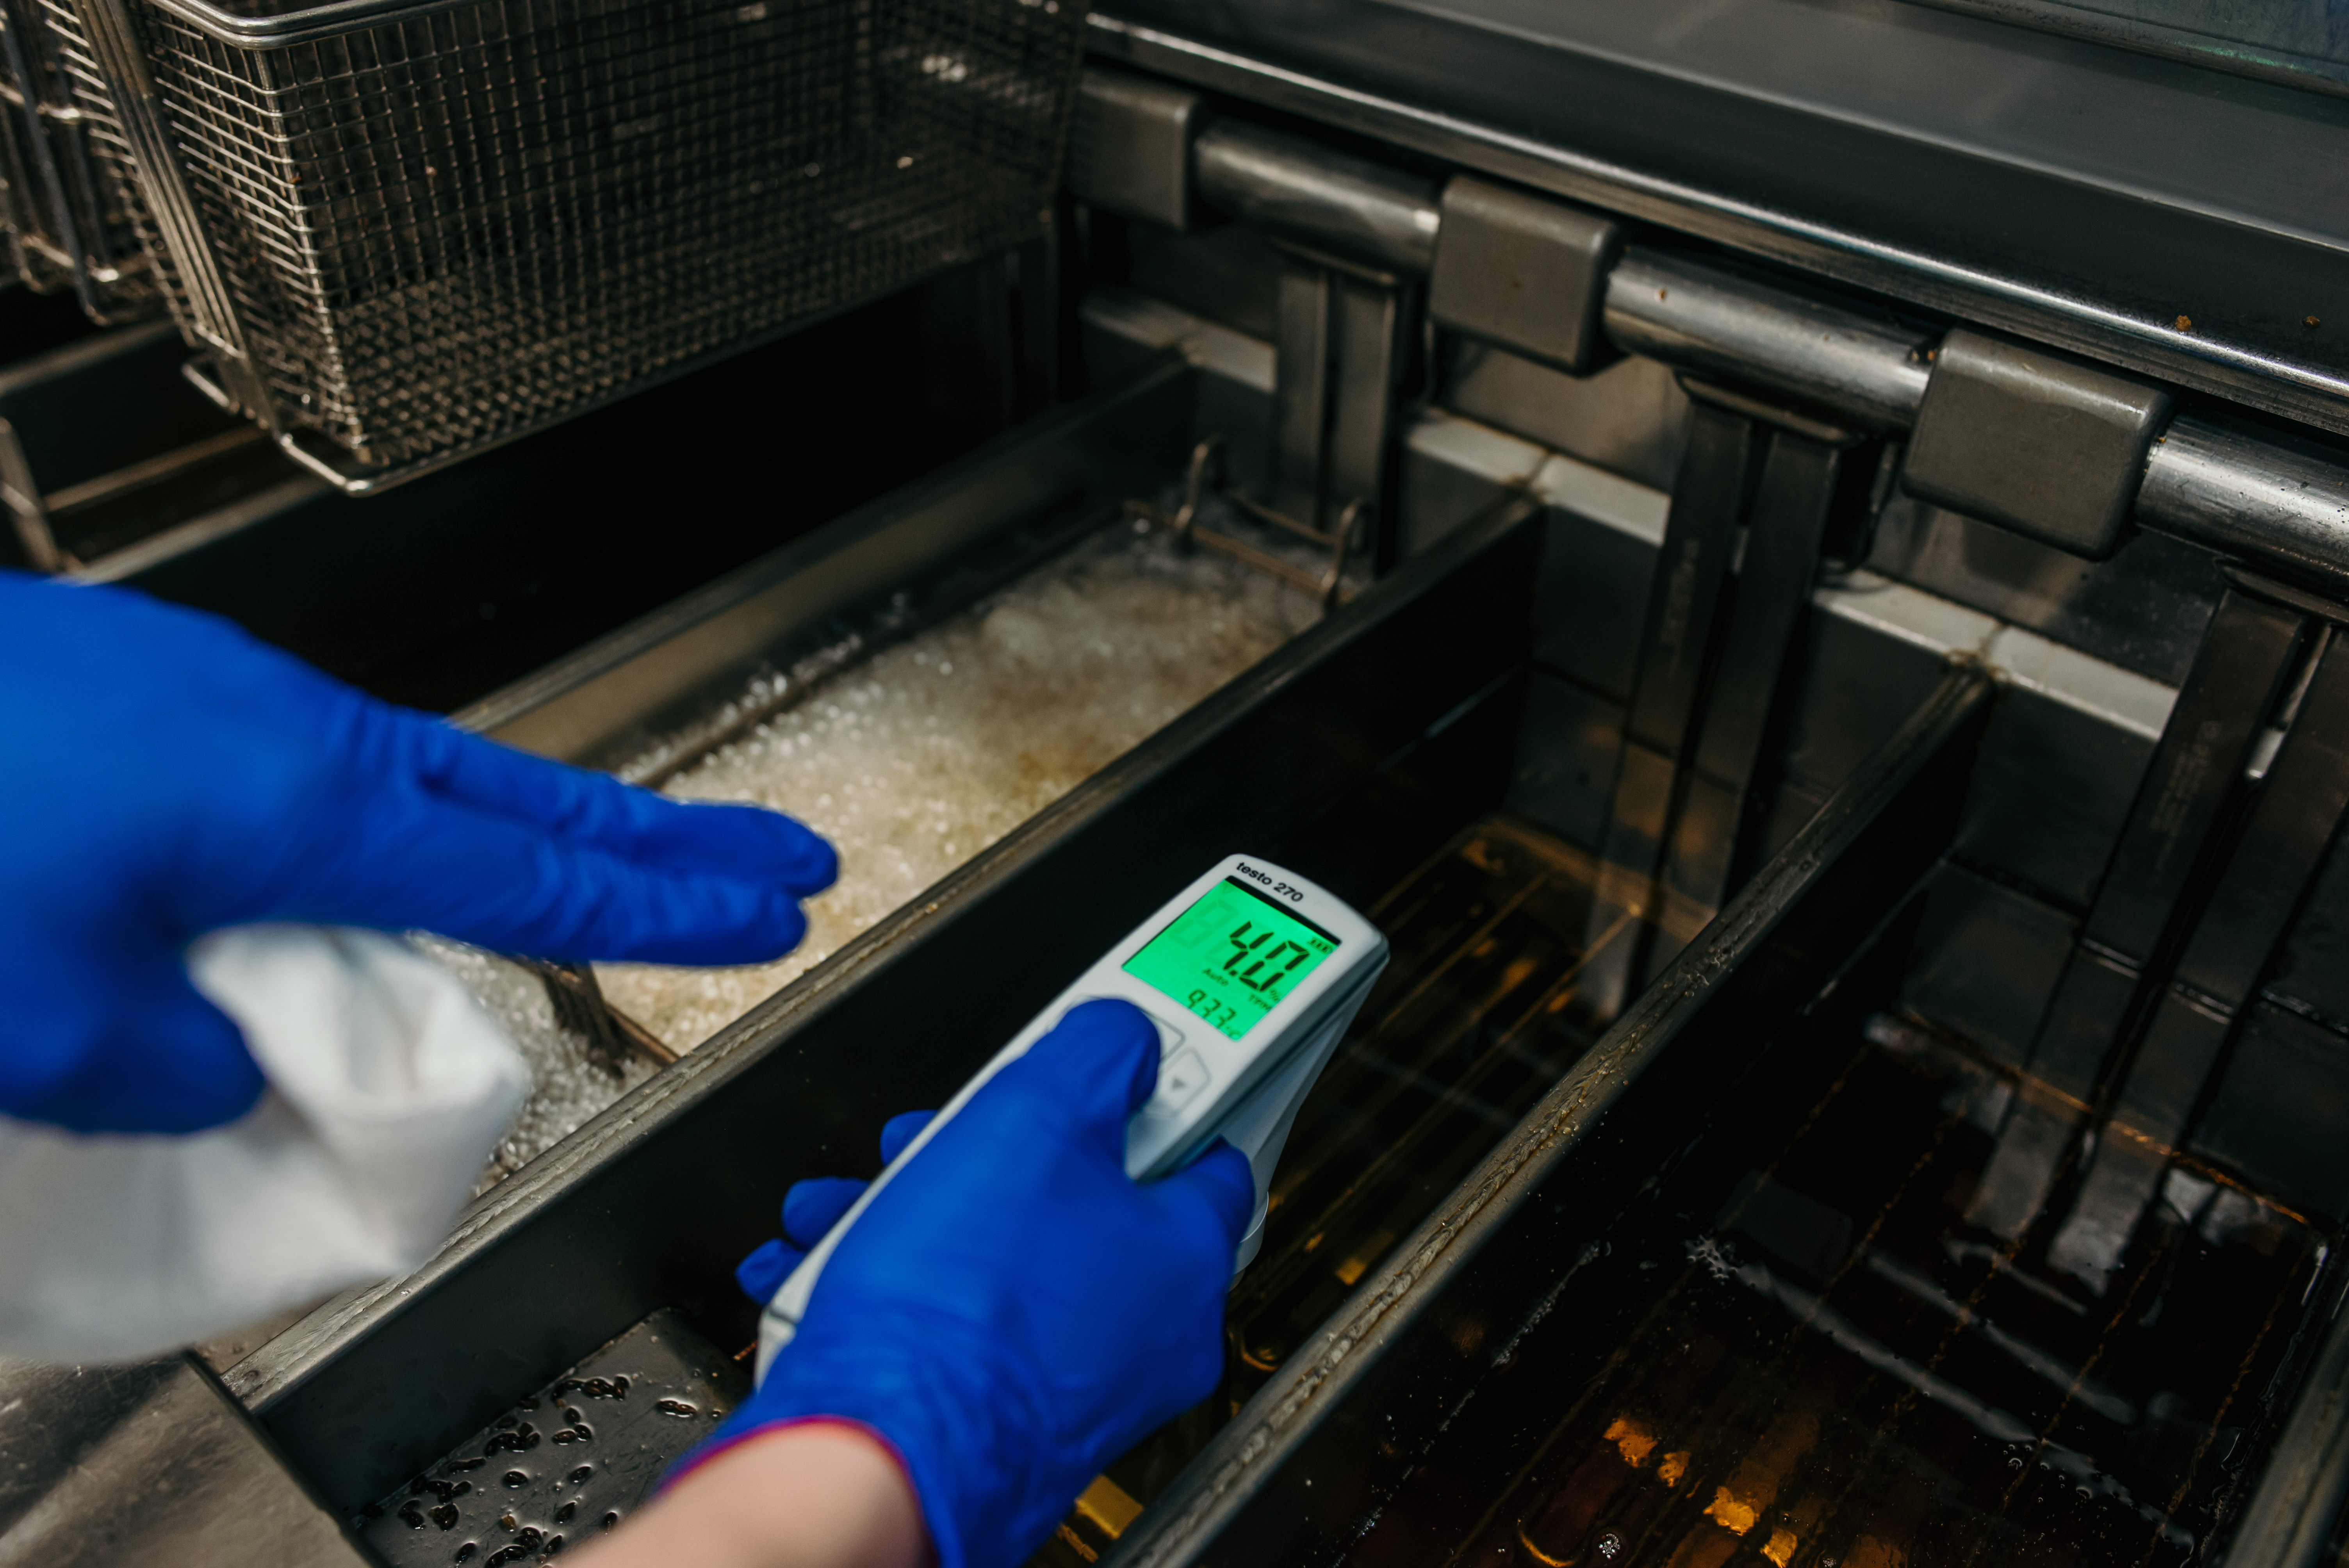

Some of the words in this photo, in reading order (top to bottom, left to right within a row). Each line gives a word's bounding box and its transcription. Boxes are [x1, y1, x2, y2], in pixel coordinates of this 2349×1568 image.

[1236, 862, 1273, 885] testo
[1273, 882, 1304, 902] 270
[1223, 921, 1310, 991] 4.0
[1202, 968, 1229, 986] Auto
